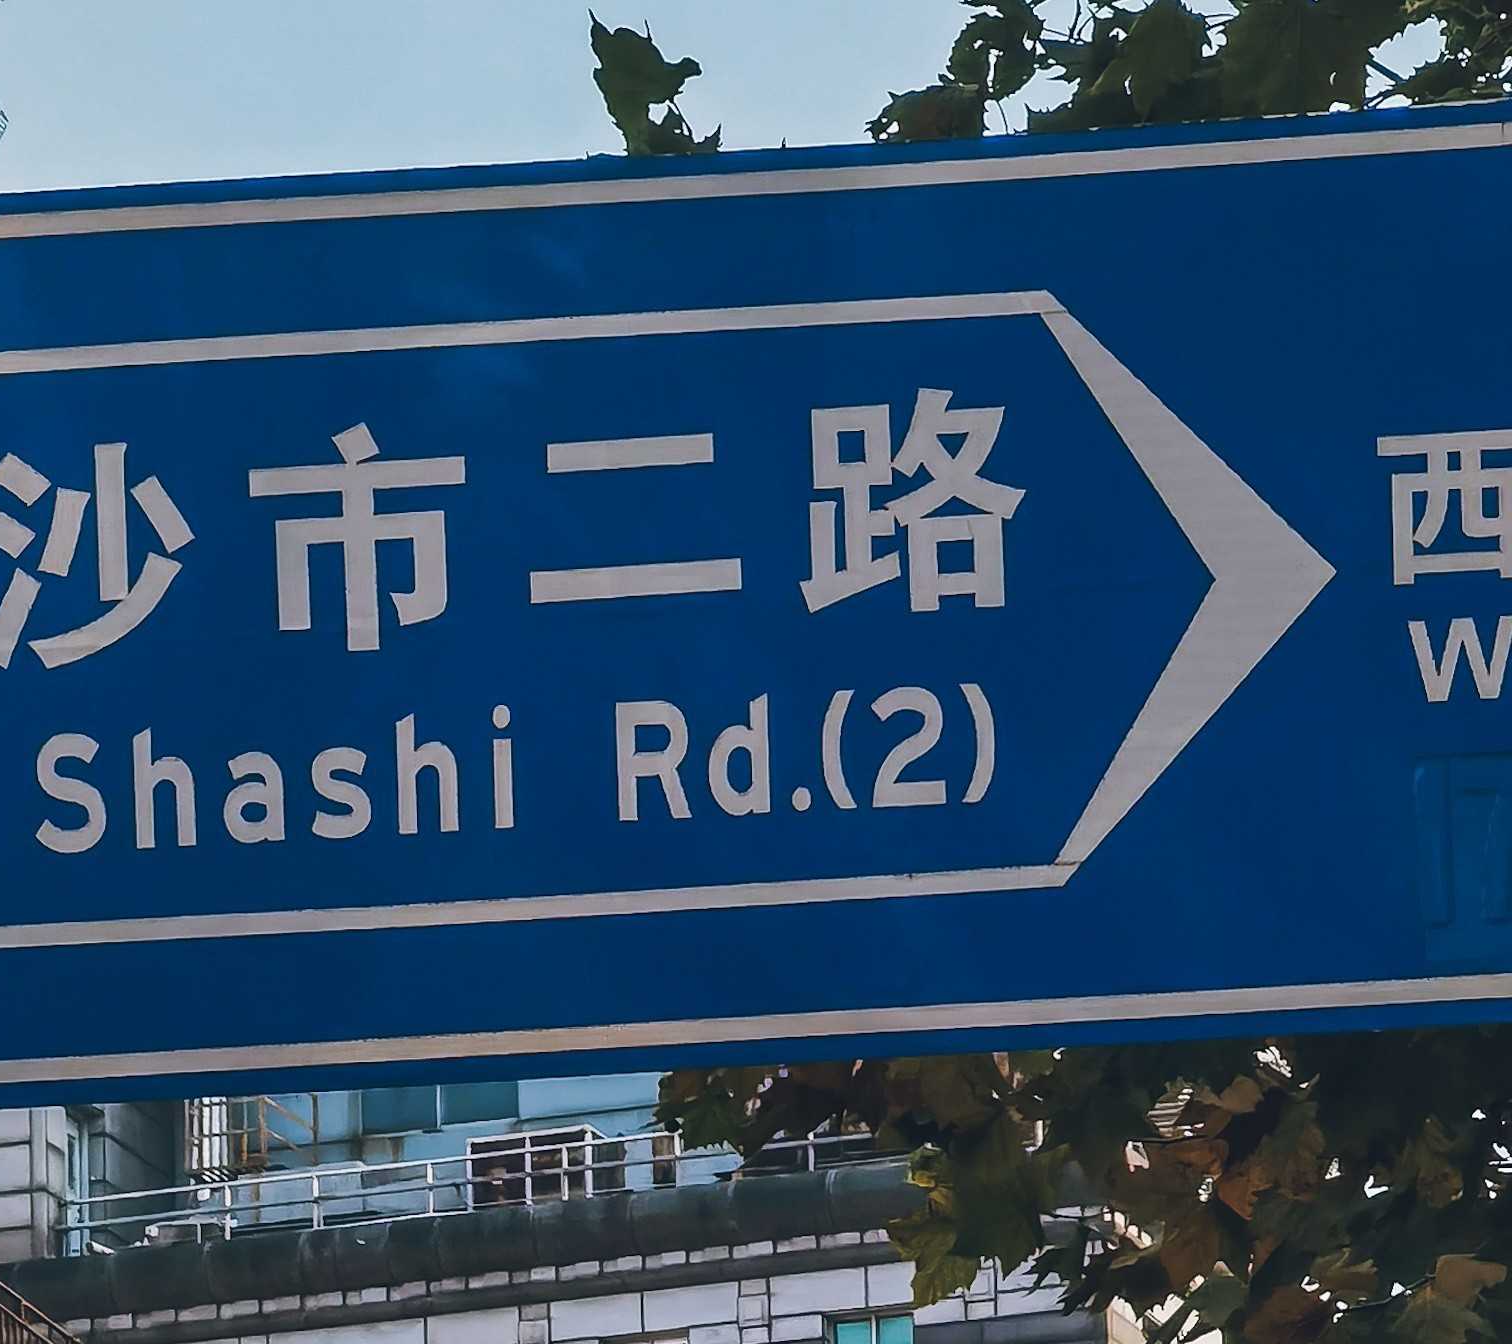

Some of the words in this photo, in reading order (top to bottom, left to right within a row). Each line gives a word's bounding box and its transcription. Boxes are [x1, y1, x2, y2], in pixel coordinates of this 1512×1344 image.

[1377, 430, 1512, 585] 西
[1408, 615, 1512, 702] W
[35, 704, 514, 854] Shashi
[615, 683, 995, 821] Rd.(2)
